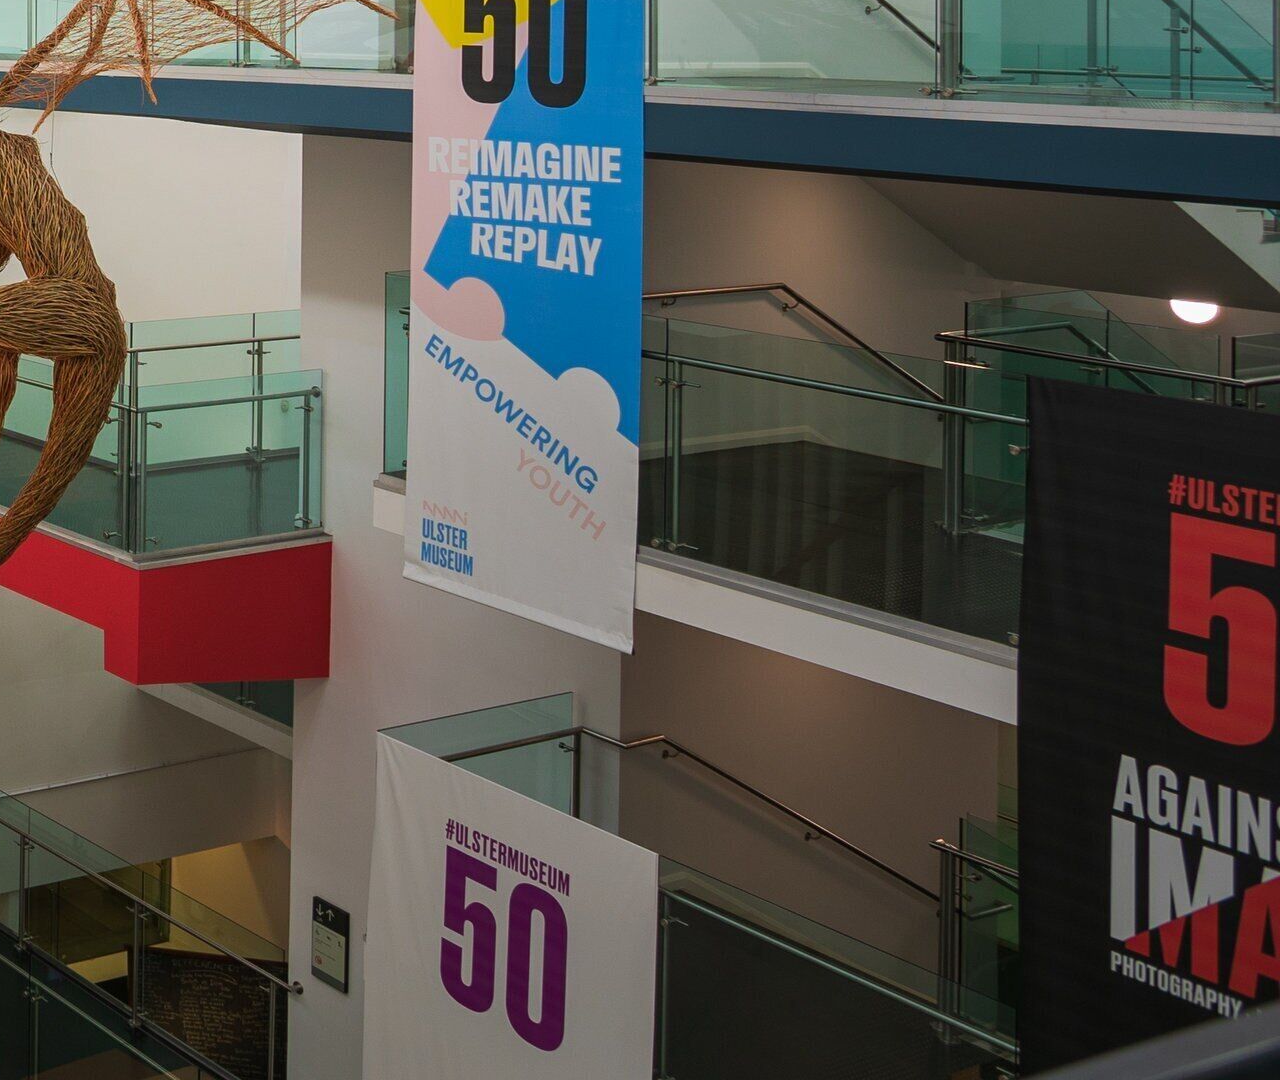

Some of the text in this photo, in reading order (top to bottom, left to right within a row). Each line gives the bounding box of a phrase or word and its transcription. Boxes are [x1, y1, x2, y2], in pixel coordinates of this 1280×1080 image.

[428, 136, 621, 183] REIMAGINE
[449, 180, 592, 227] REMAKE
[471, 223, 602, 277] REPLAY
[424, 333, 599, 494] EMPOWERING
[517, 448, 607, 541] YOUTH
[1168, 473, 1280, 527] #ULSTE
[421, 541, 474, 577] MUSEUM
[422, 517, 468, 551] ULSTER
[1163, 511, 1277, 747] 5
[1112, 753, 1280, 863] AGAIN
[445, 818, 570, 897] #ULSTERMUSEUM
[1110, 814, 1280, 999] IMA
[440, 844, 568, 1052] 50
[1110, 950, 1243, 1020] PHOTOGRAPHY
